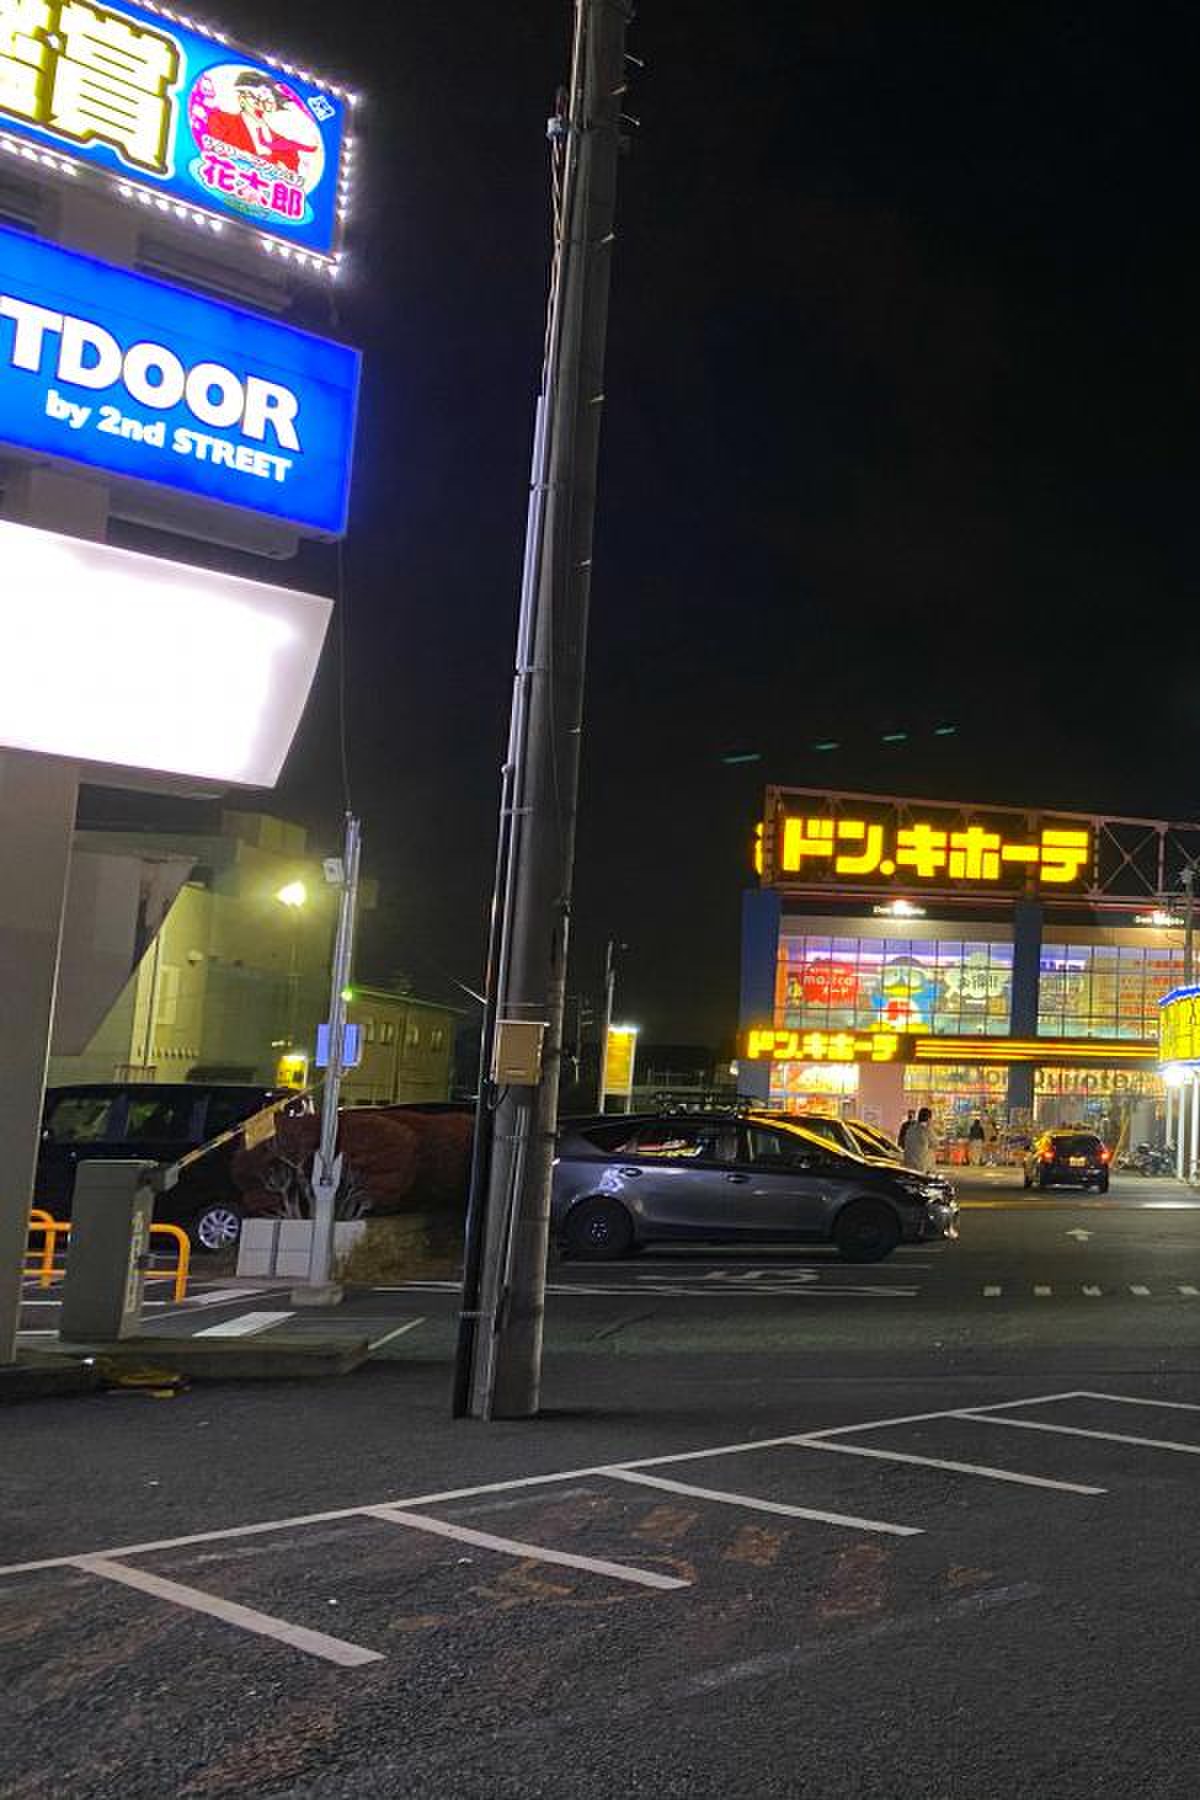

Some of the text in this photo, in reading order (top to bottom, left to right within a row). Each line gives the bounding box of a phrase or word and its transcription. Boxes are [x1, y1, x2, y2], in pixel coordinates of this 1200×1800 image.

[201, 153, 305, 219] 花太郎
[45, 388, 293, 482] by 2nd STREET
